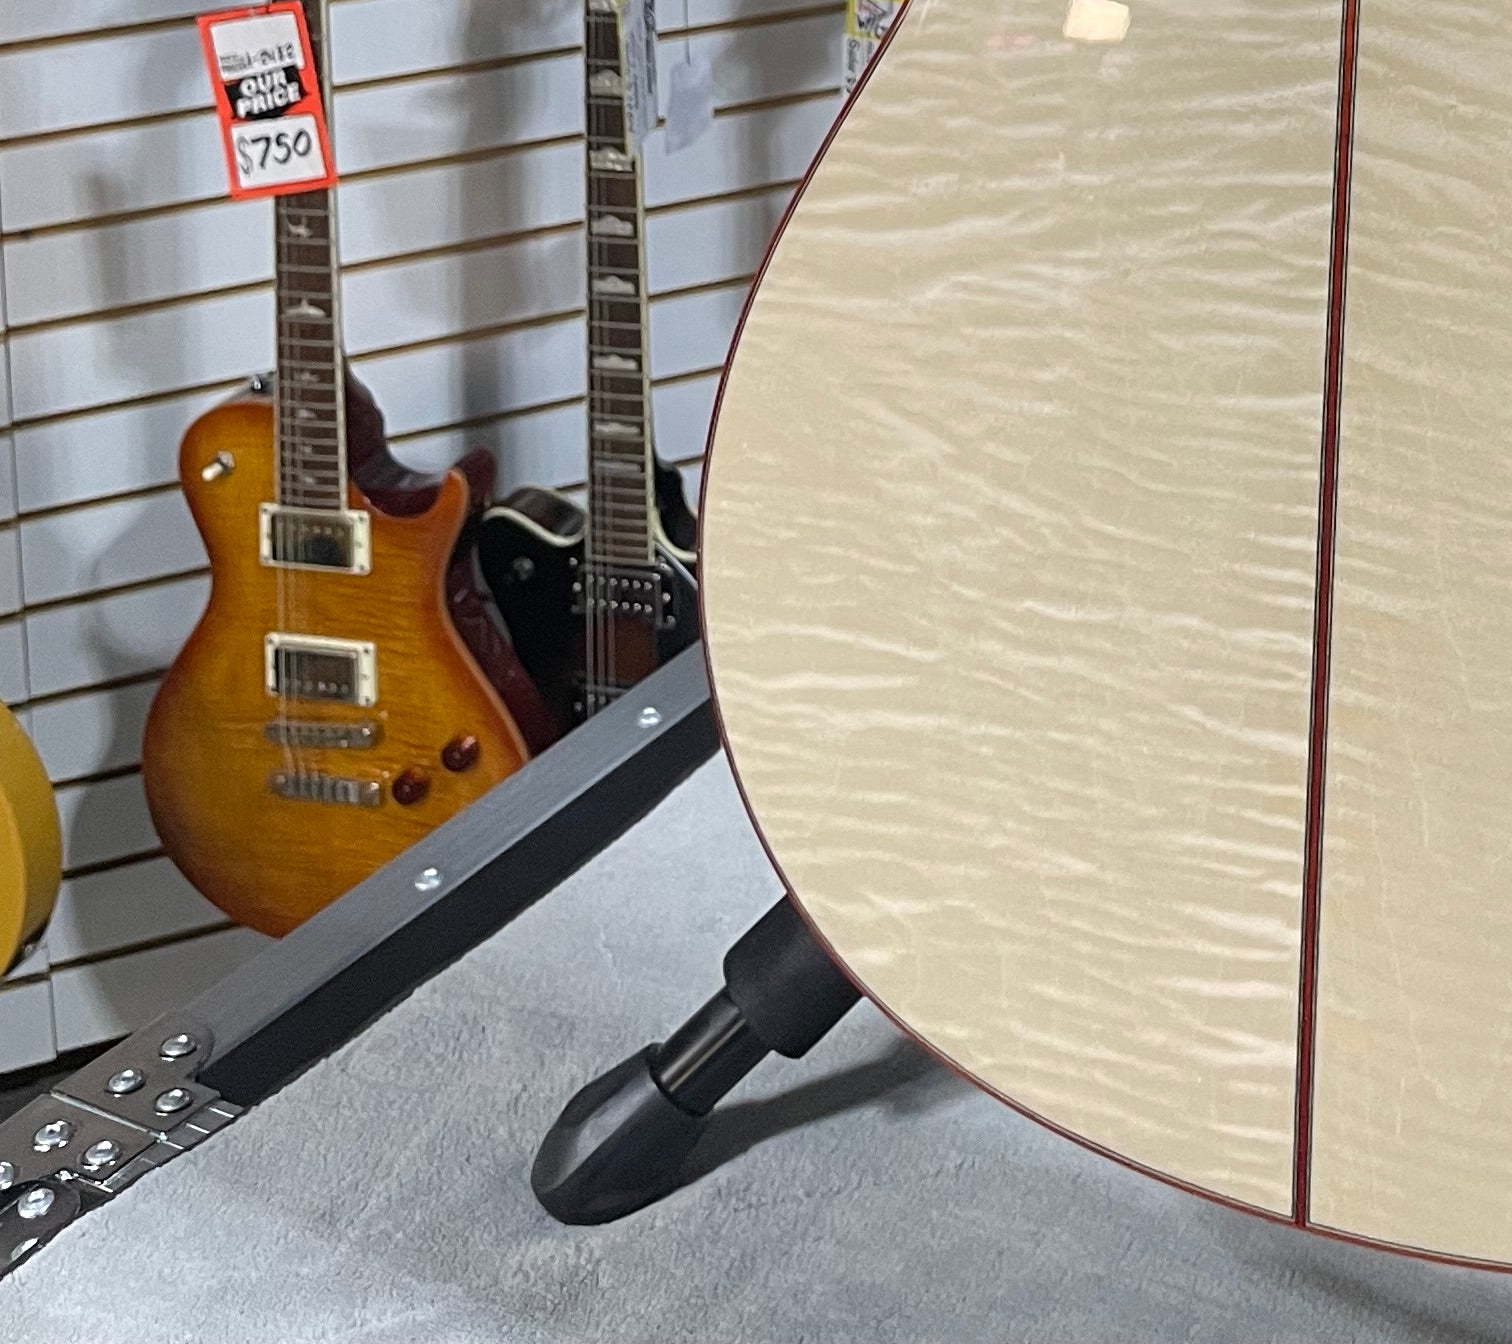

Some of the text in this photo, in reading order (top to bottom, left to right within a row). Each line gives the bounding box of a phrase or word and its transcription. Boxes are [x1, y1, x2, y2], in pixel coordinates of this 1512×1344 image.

[237, 83, 300, 118] PRICE
[239, 69, 288, 98] OUR
[237, 127, 312, 176] $750
